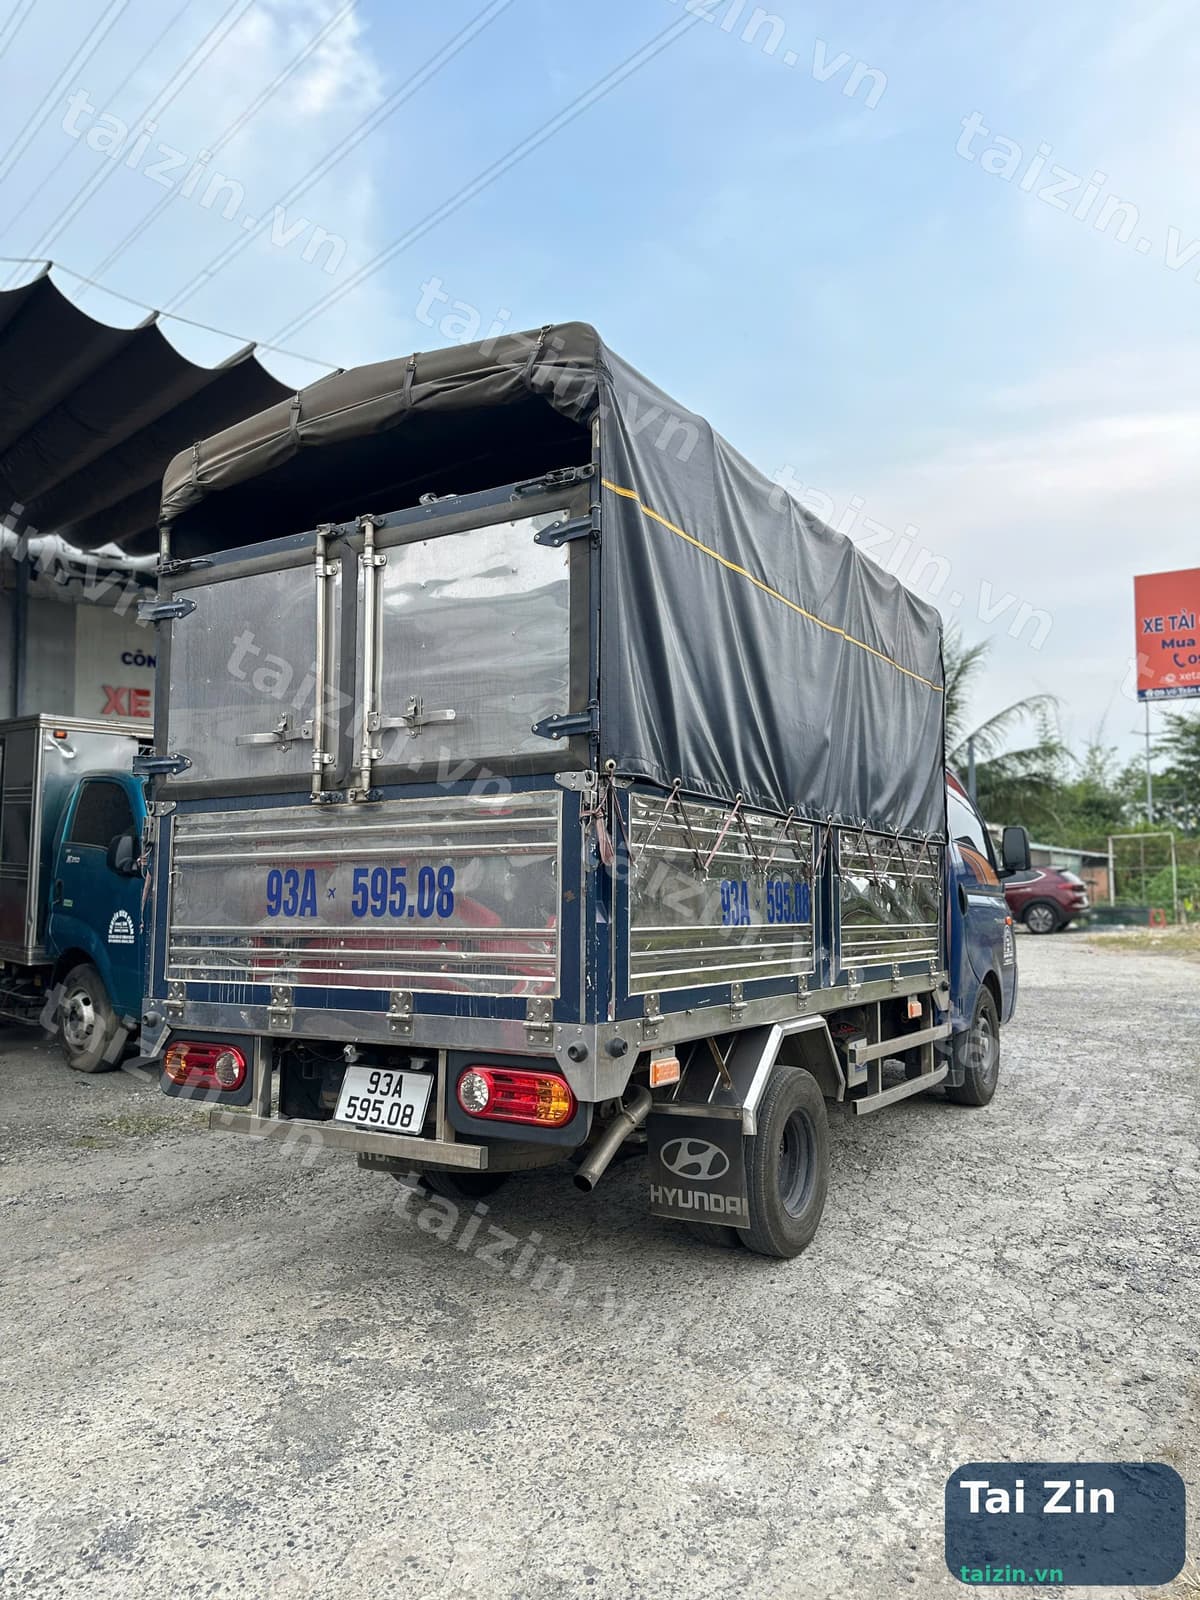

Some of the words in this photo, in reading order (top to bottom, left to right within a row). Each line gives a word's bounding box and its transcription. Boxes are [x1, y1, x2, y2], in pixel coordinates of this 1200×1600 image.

[1143, 617, 1164, 634] XE
[1161, 638, 1196, 650] Mua
[101, 684, 152, 718] XE
[266, 869, 318, 918] 93A
[351, 865, 455, 919] 595.08
[720, 879, 751, 927] 93A
[766, 880, 811, 924] 595.08
[367, 1071, 404, 1099] 93A
[345, 1095, 415, 1128] 595.08
[650, 1184, 749, 1217] HYUNDAI
